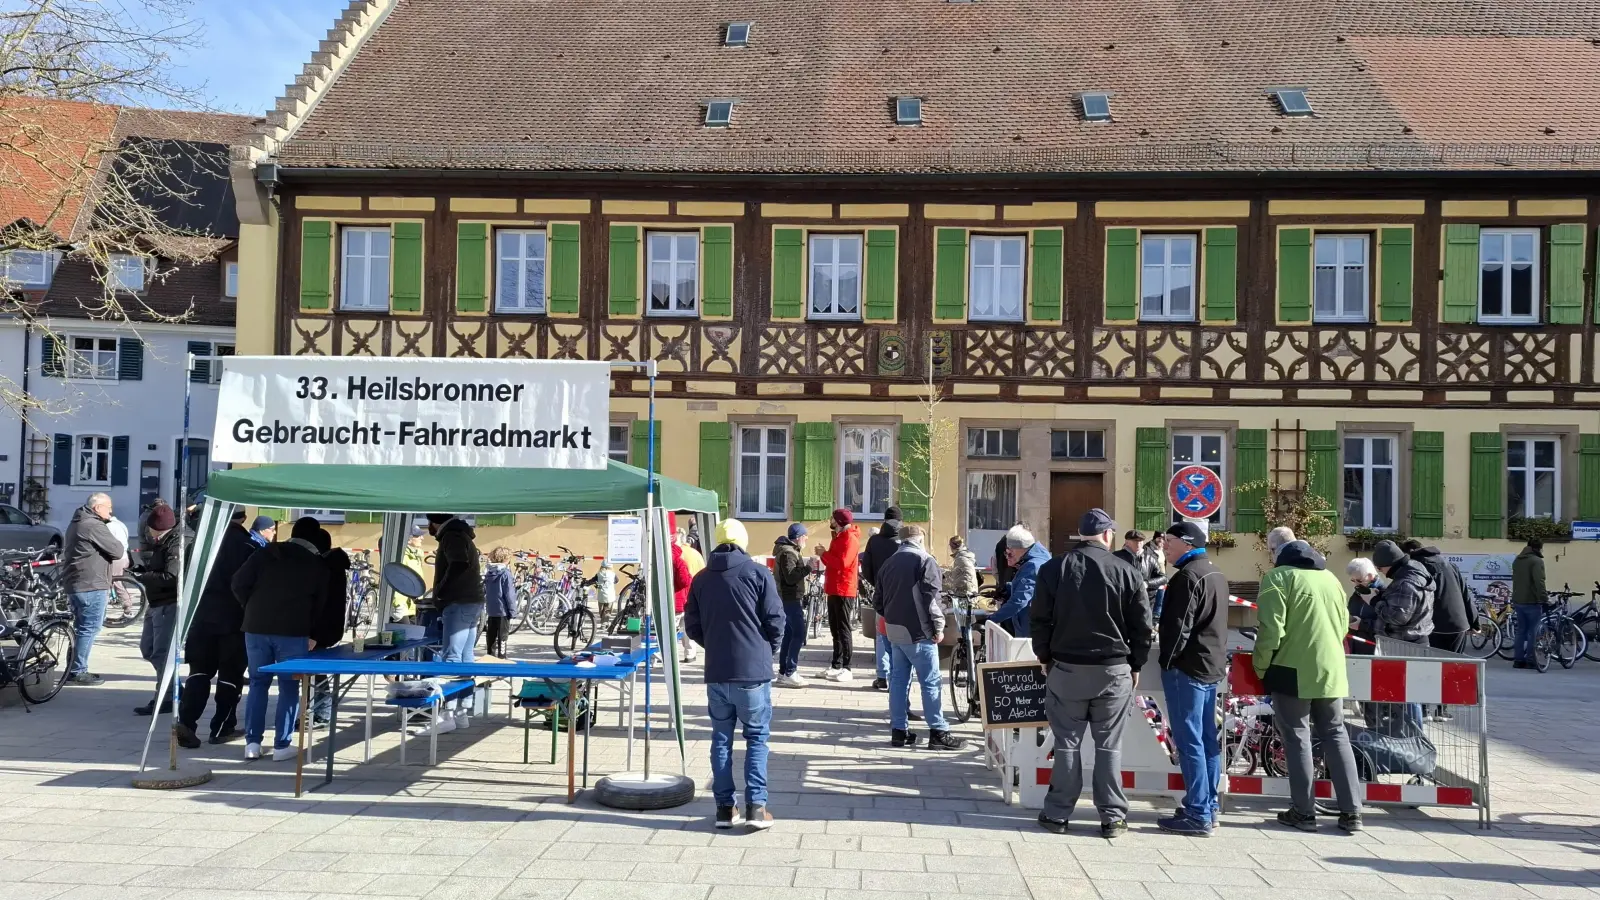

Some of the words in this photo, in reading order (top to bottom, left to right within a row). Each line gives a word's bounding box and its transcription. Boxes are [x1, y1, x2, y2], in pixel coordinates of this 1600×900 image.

[296, 377, 337, 400] 33.
[347, 376, 525, 402] Heilsbronner
[232, 418, 592, 450] Gebraucht-Fahrradmarkt
[1031, 471, 1037, 480] 9
[994, 696, 1011, 708] 50
[1015, 696, 1032, 705] Meter
[1008, 706, 1039, 720] Atelier
